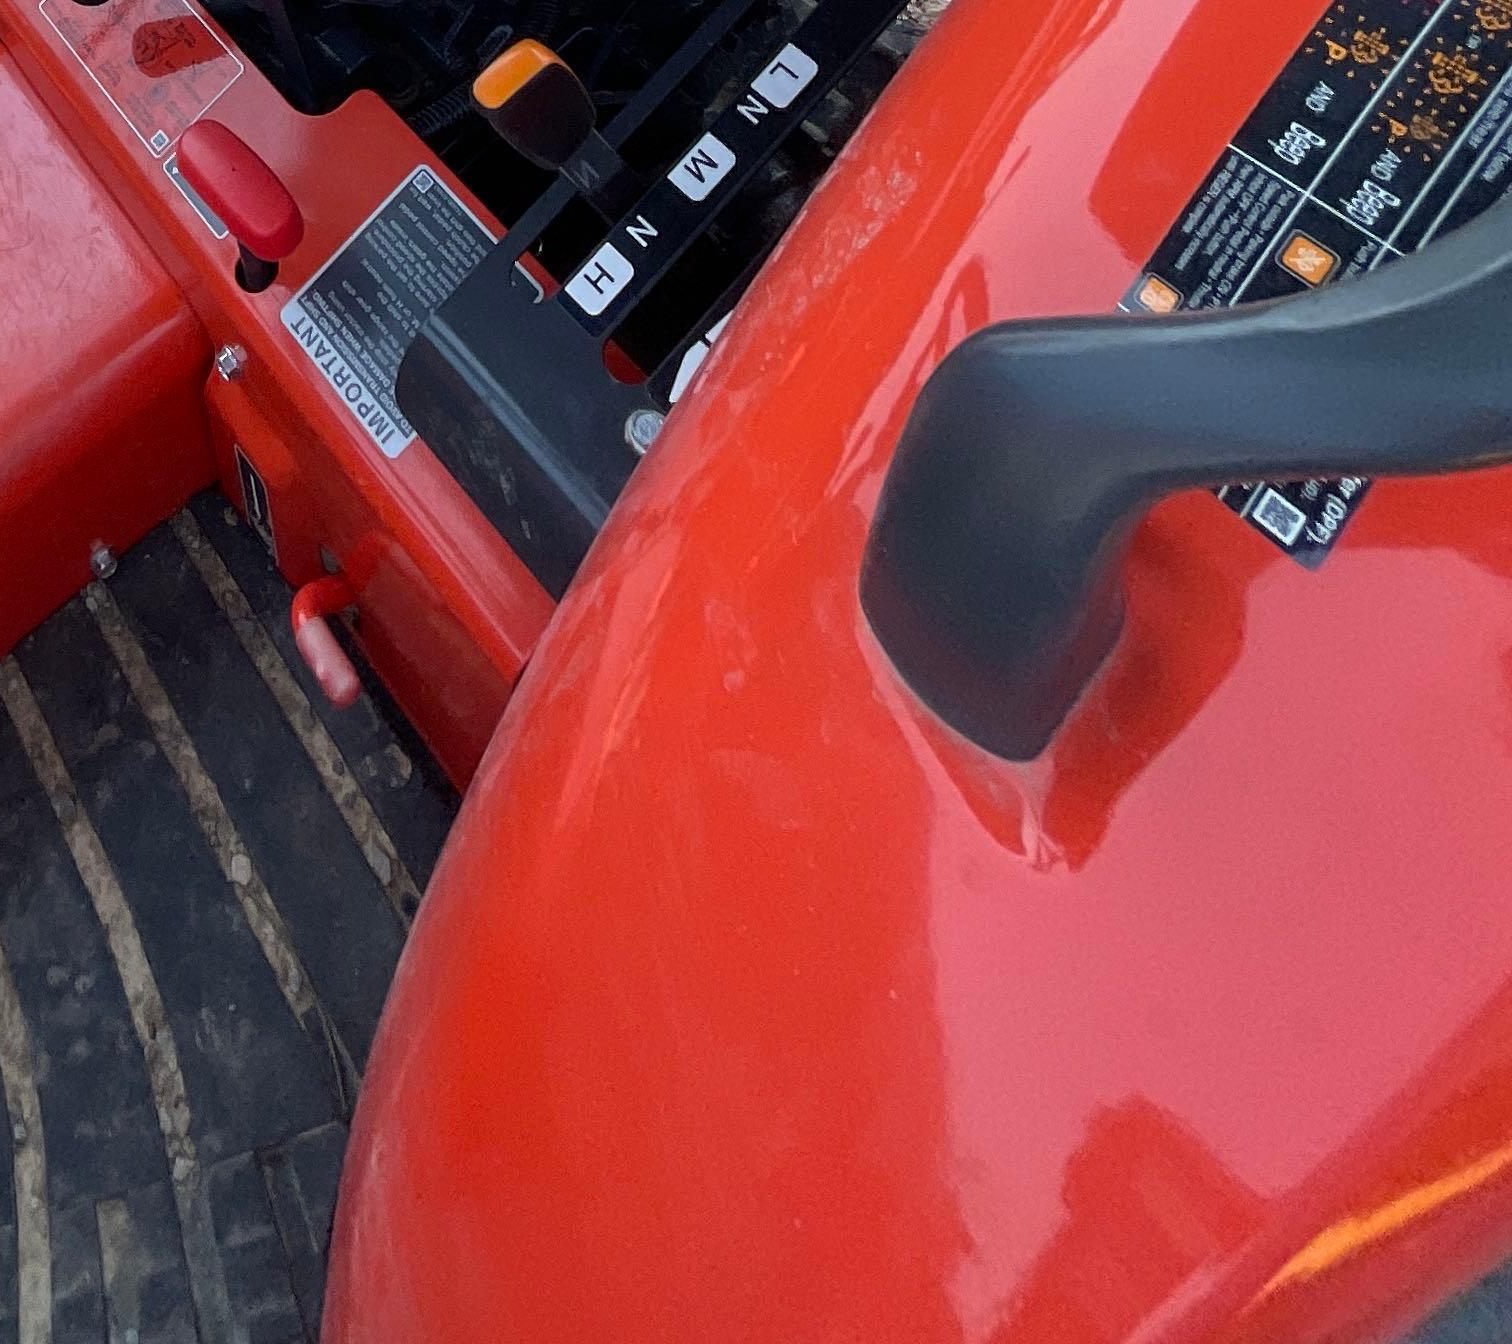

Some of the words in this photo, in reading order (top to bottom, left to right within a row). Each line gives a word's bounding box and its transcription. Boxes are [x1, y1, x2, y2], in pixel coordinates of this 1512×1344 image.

[1305, 80, 1335, 113] AND
[1267, 121, 1326, 165] Beep
[1370, 147, 1402, 182] AND
[1338, 179, 1402, 227] Beep
[626, 215, 660, 250] N
[583, 263, 616, 298] H
[301, 294, 320, 317] SHIFT
[310, 288, 342, 327] SHIFTING.
[318, 315, 334, 335] AND
[340, 325, 361, 351] WHEN
[290, 312, 396, 443] IMPORTANT
[332, 333, 380, 393] TRANSMISSION
[359, 349, 390, 387] DAMAGE
